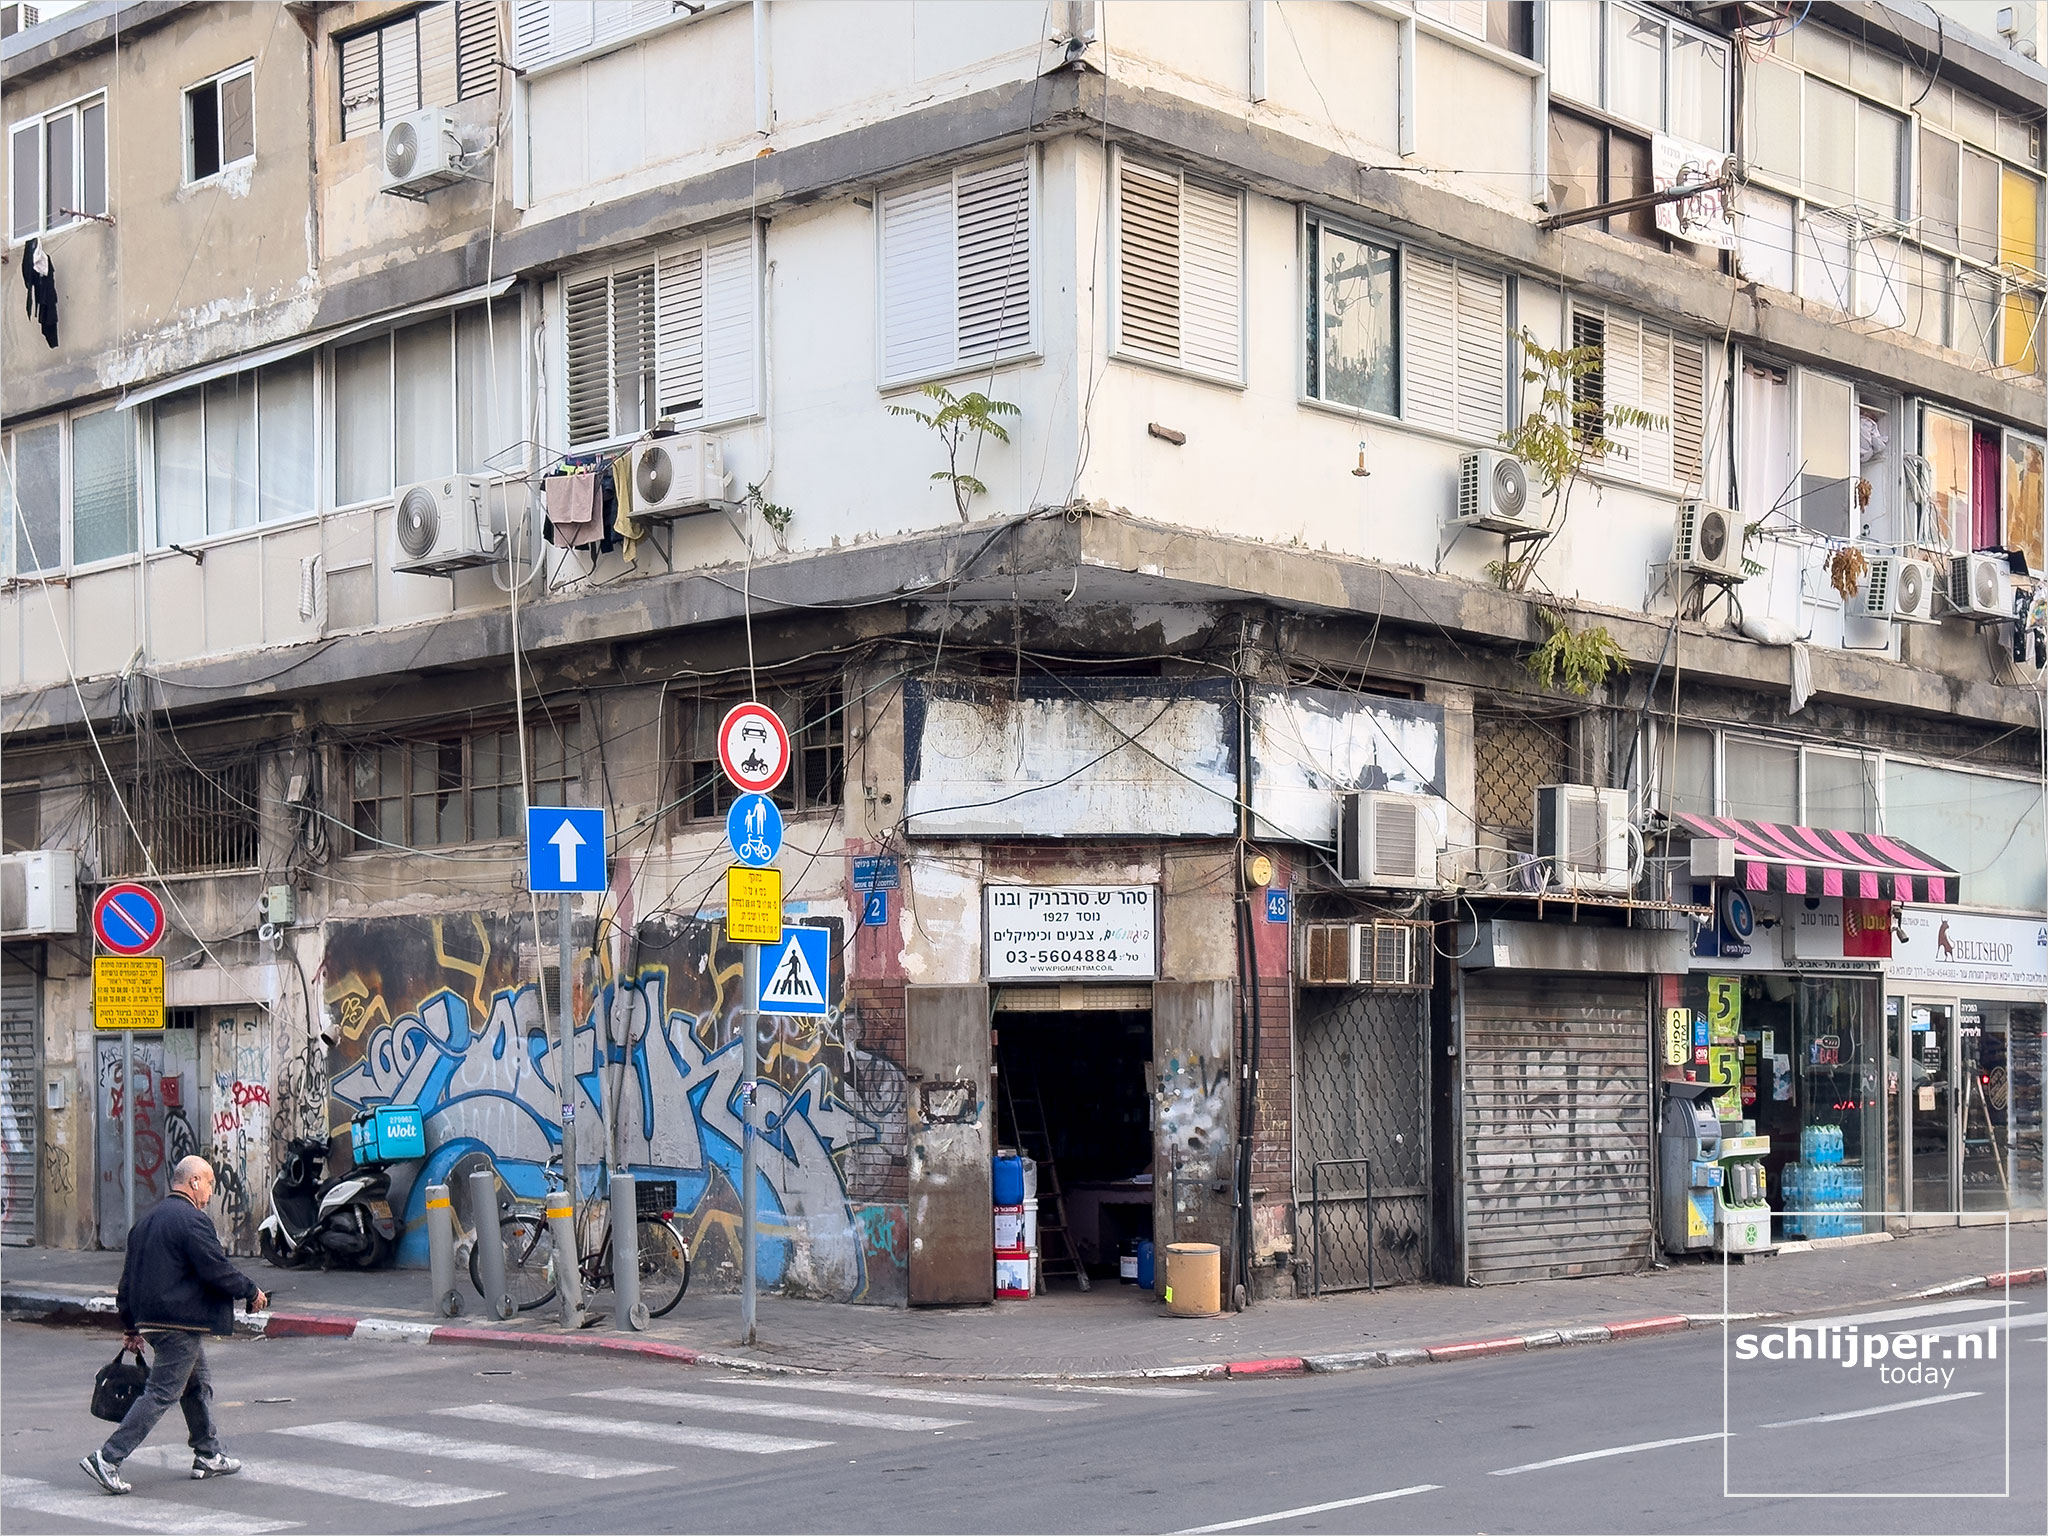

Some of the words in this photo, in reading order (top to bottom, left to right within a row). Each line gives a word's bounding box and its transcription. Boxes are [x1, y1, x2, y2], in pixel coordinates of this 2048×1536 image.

[994, 892, 1021, 906] ובנו
[1029, 892, 1089, 909] סרברניק
[1117, 891, 1148, 905] סהר
[871, 898, 881, 917] 2
[1269, 897, 1286, 915] 43
[1043, 912, 1069, 922] 1927
[1076, 911, 1101, 922] נוסד
[1801, 912, 1817, 924] טוב
[1818, 913, 1840, 927] בחור
[1863, 915, 1886, 931] טוטו
[993, 928, 1051, 944] וכימיקלים
[1057, 930, 1094, 941] צבעים
[1006, 949, 1118, 964] 03-5604884
[1957, 941, 2013, 963] BELTSHOP
[1716, 984, 1731, 1019] 5
[1819, 1048, 1839, 1065] BAR
[387, 1124, 417, 1138] Wolt
